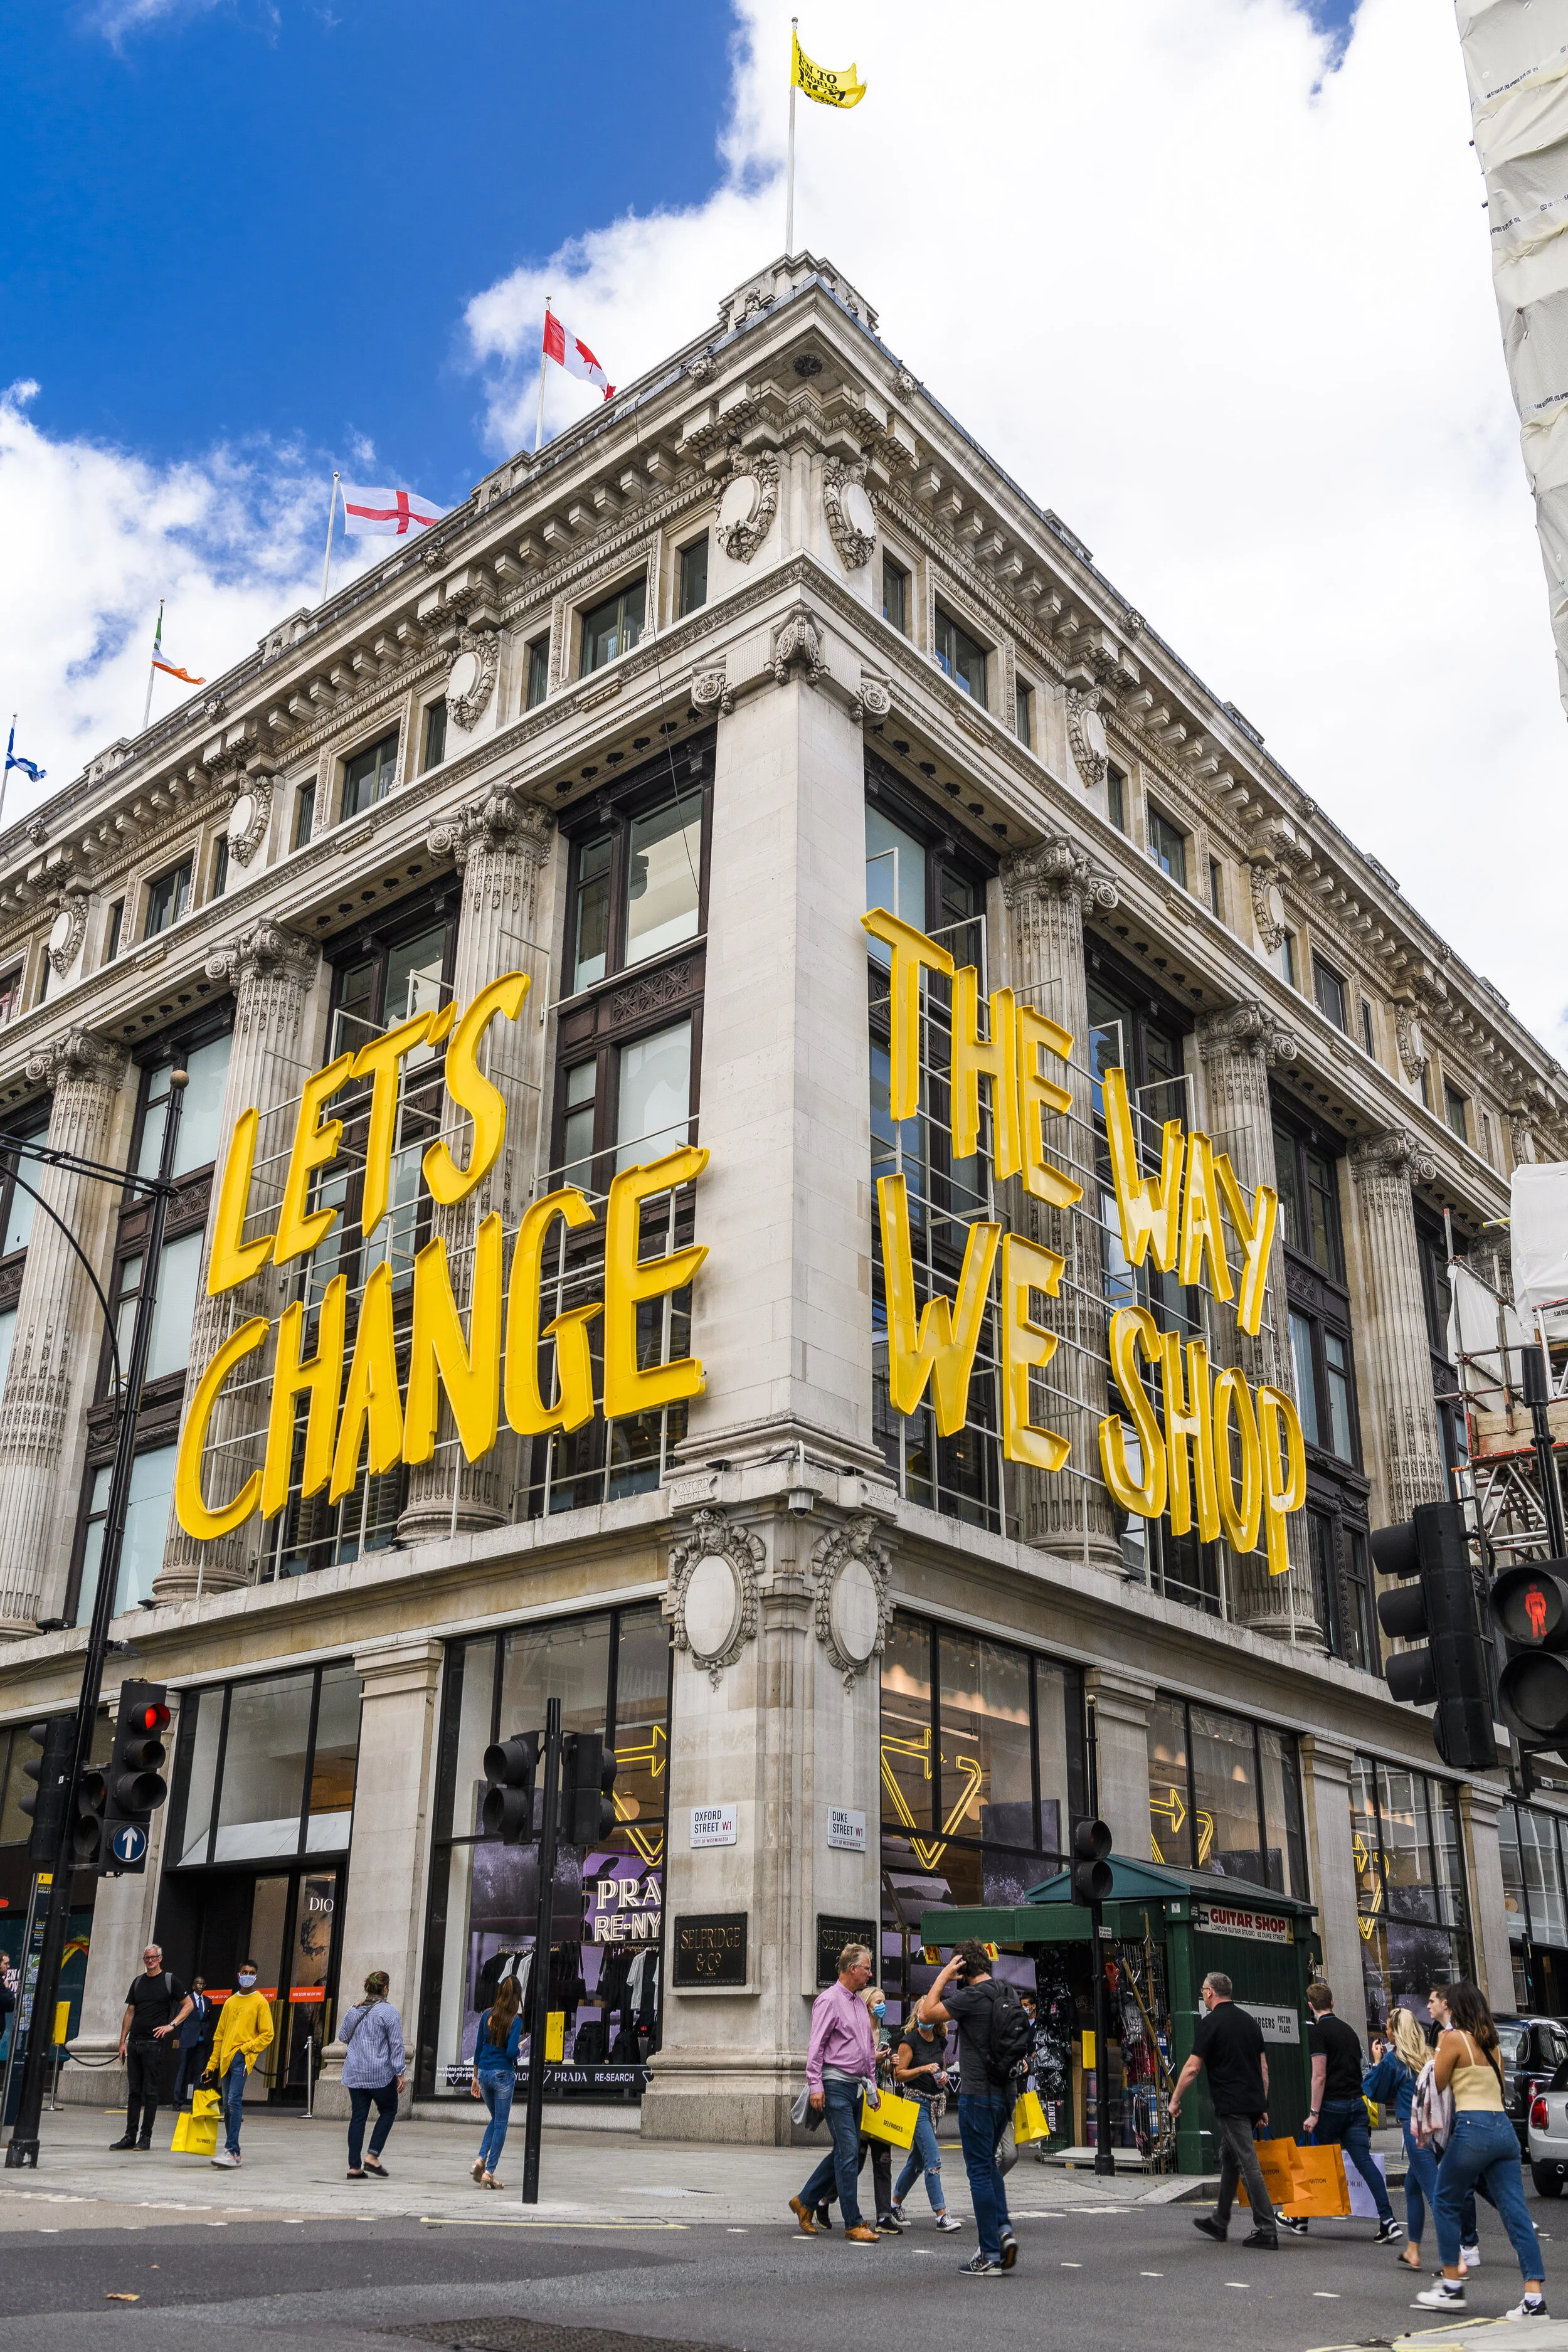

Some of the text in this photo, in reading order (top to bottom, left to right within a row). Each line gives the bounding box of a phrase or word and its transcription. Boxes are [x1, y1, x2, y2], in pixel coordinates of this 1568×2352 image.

[805, 68, 838, 90] WORLD
[817, 70, 837, 84] TO
[860, 907, 1084, 1210] THE
[208, 970, 531, 1297] LET'S
[1101, 1067, 1279, 1337] WAY
[876, 1173, 1072, 1472] WE
[175, 1145, 710, 1540] CHANGE
[1098, 1305, 1306, 1576] SHOP
[678, 1478, 709, 1494] OXFORD
[694, 1810, 722, 1822] OXFORD
[832, 1811, 847, 1823] DUKE
[694, 1821, 731, 1833] STREET W1
[832, 1823, 863, 1838] STREET W1
[596, 1877, 662, 1909] PRA
[309, 1897, 334, 1912] DIO
[594, 1912, 661, 1941] RE-NY
[1210, 1908, 1254, 1929] GUITAR
[1255, 1915, 1286, 1933] SHOP
[681, 1927, 740, 1949] SELFRIDGE
[926, 1946, 938, 1961] £1
[985, 1944, 993, 1957] 1
[696, 1954, 705, 1971] &
[1254, 2015, 1291, 2030] RGERS PICTON
[1279, 2025, 1291, 2033] PLACE
[554, 2072, 587, 2082] PRADA
[595, 2073, 634, 2082] RE-SEARCH
[1047, 2100, 1056, 2131] LONDON
[883, 2119, 903, 2132] SELFRIDGES
